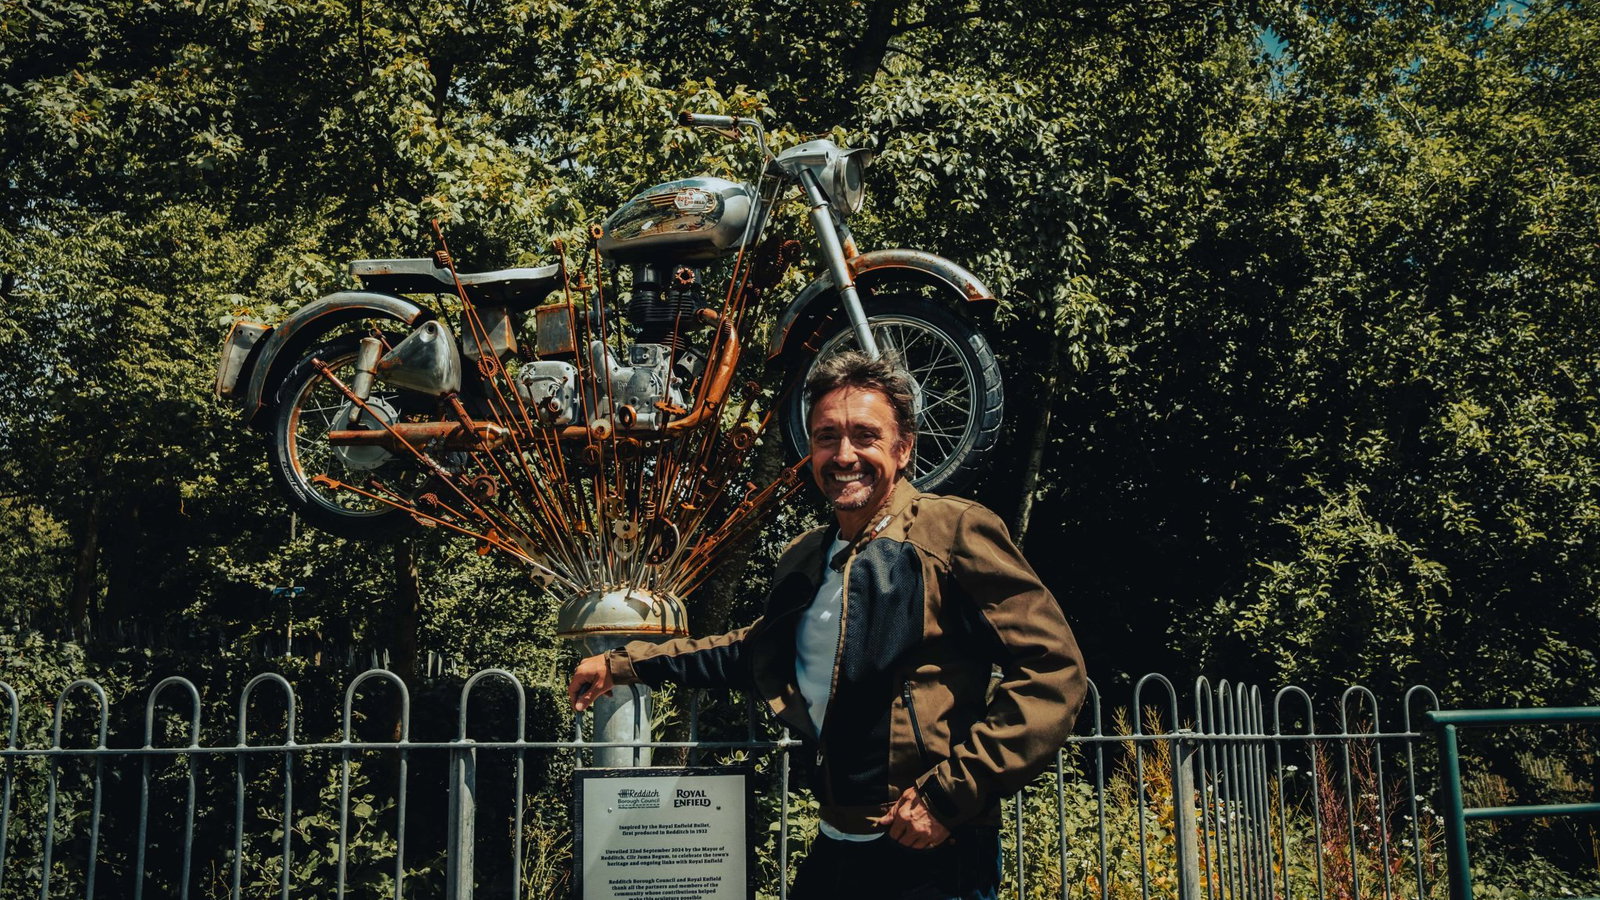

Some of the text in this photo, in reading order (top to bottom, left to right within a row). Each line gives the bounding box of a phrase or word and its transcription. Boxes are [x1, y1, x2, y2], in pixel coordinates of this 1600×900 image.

[630, 789, 660, 798] Redditch
[676, 789, 707, 798] ROYAL
[674, 799, 711, 808] ENFIELD
